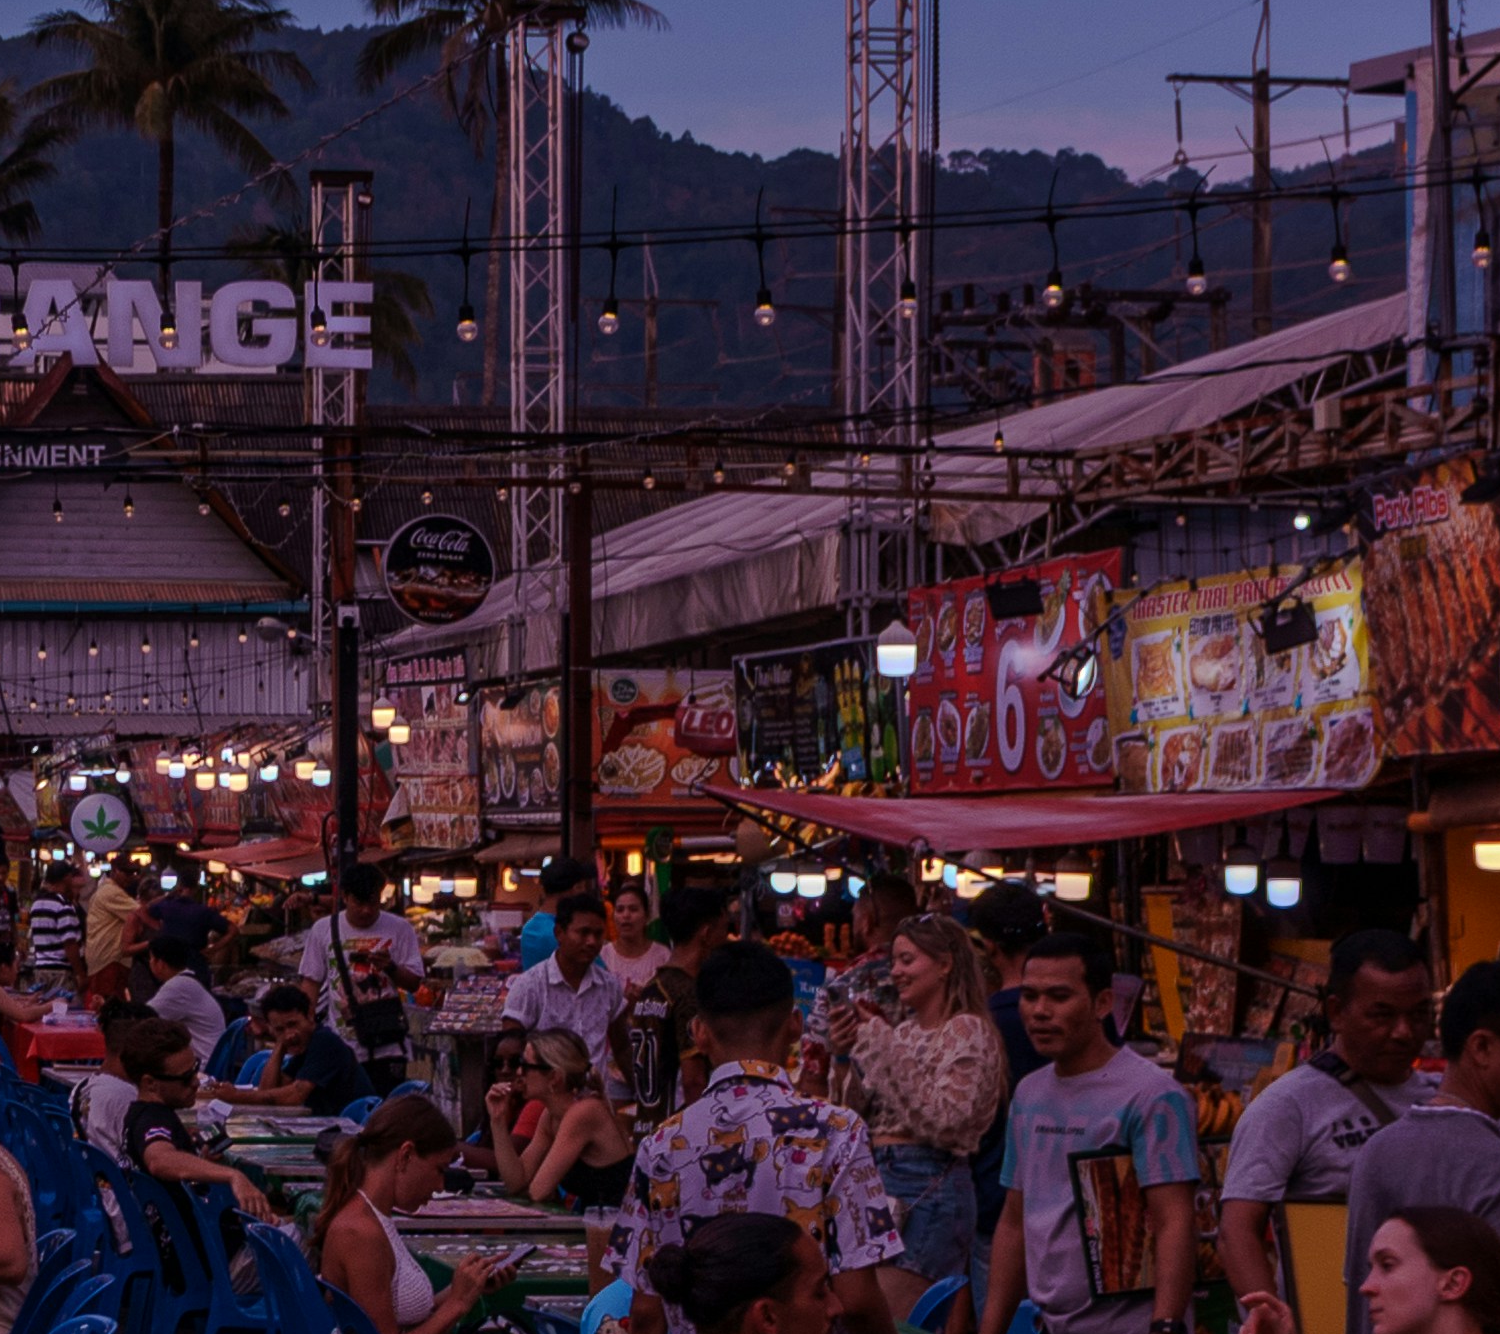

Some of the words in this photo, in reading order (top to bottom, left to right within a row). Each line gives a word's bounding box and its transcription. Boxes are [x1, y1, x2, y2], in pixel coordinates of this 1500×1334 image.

[1373, 492, 1412, 531] Pork
[1413, 485, 1450, 524] Ribs
[409, 527, 472, 552] Coca-Cola
[1132, 591, 1191, 621] MASTER
[1196, 584, 1229, 611] THAI
[1233, 575, 1292, 605] PANCA
[684, 709, 735, 737] LEO
